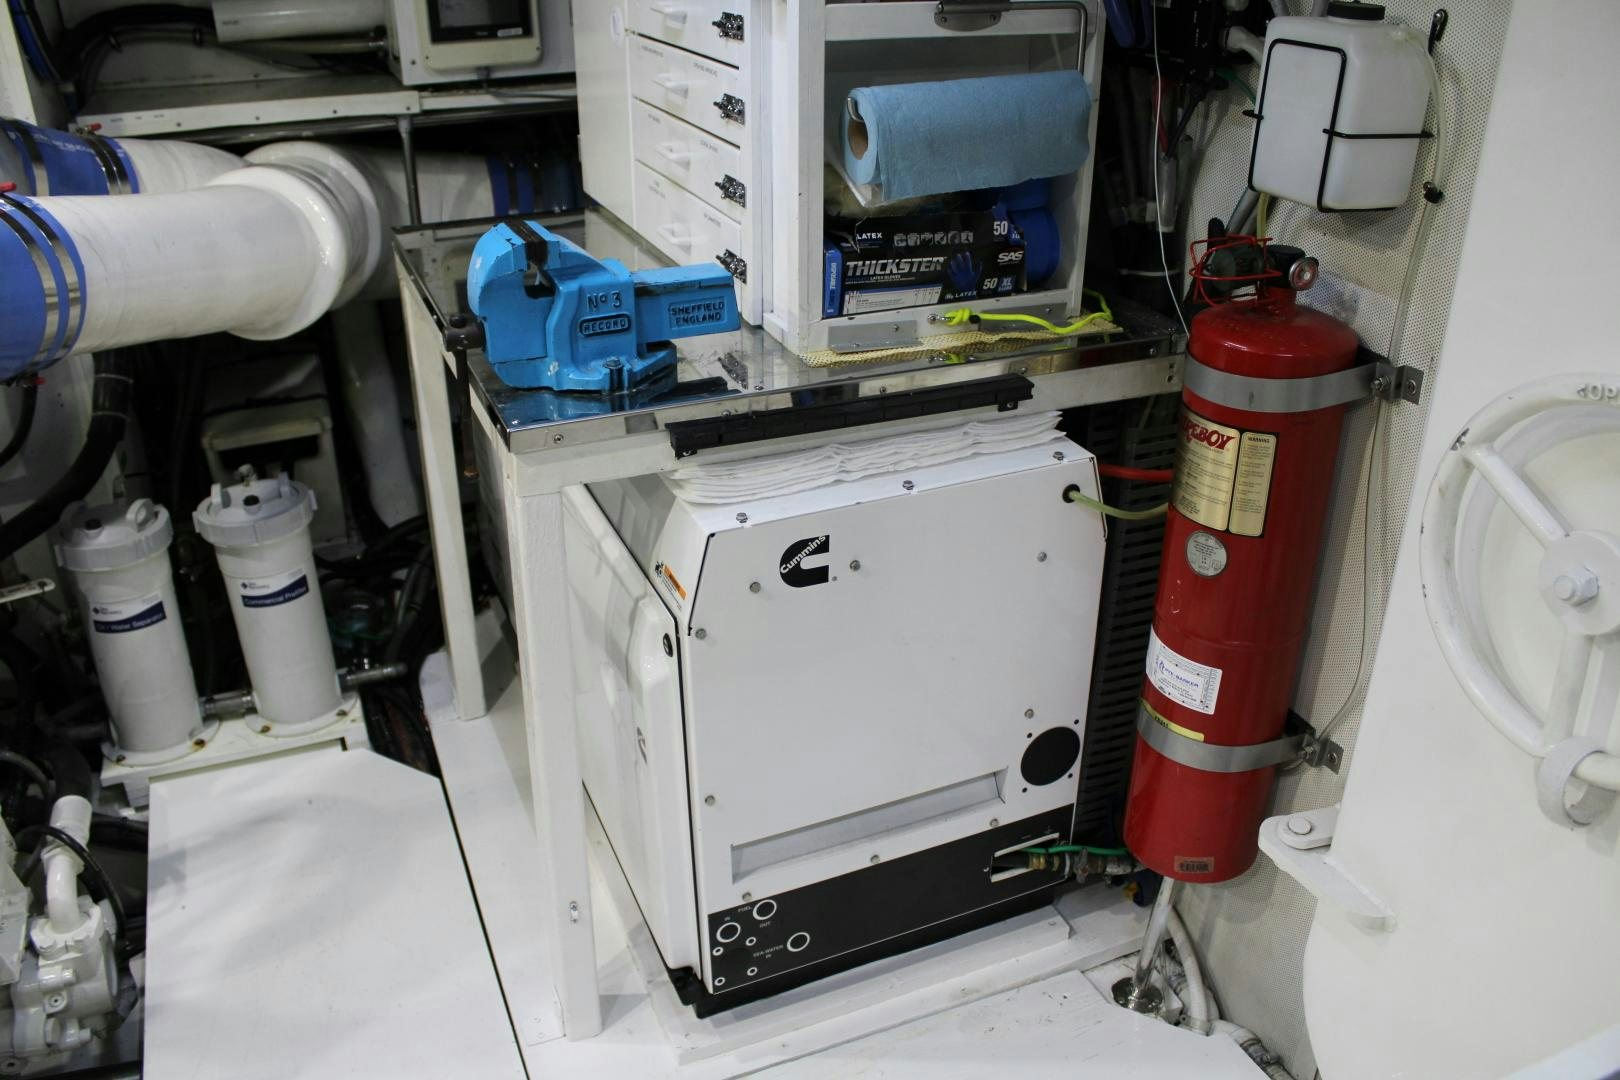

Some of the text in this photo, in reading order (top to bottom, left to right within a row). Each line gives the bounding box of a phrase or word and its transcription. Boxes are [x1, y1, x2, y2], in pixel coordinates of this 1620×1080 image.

[856, 232, 883, 240] LATEX
[993, 221, 1008, 236] 50
[997, 250, 1024, 264] SAS
[845, 256, 945, 277] THICKSTER
[982, 277, 998, 290] 50
[612, 290, 622, 309] 3
[955, 290, 977, 298] LATEX
[671, 301, 725, 317] SHEFFIELD
[583, 319, 627, 334] RECORD
[675, 312, 722, 327] ENGLAND
[780, 534, 826, 574] Cummins
[737, 905, 752, 913] FUEL
[753, 944, 784, 957] SEA-WATER
